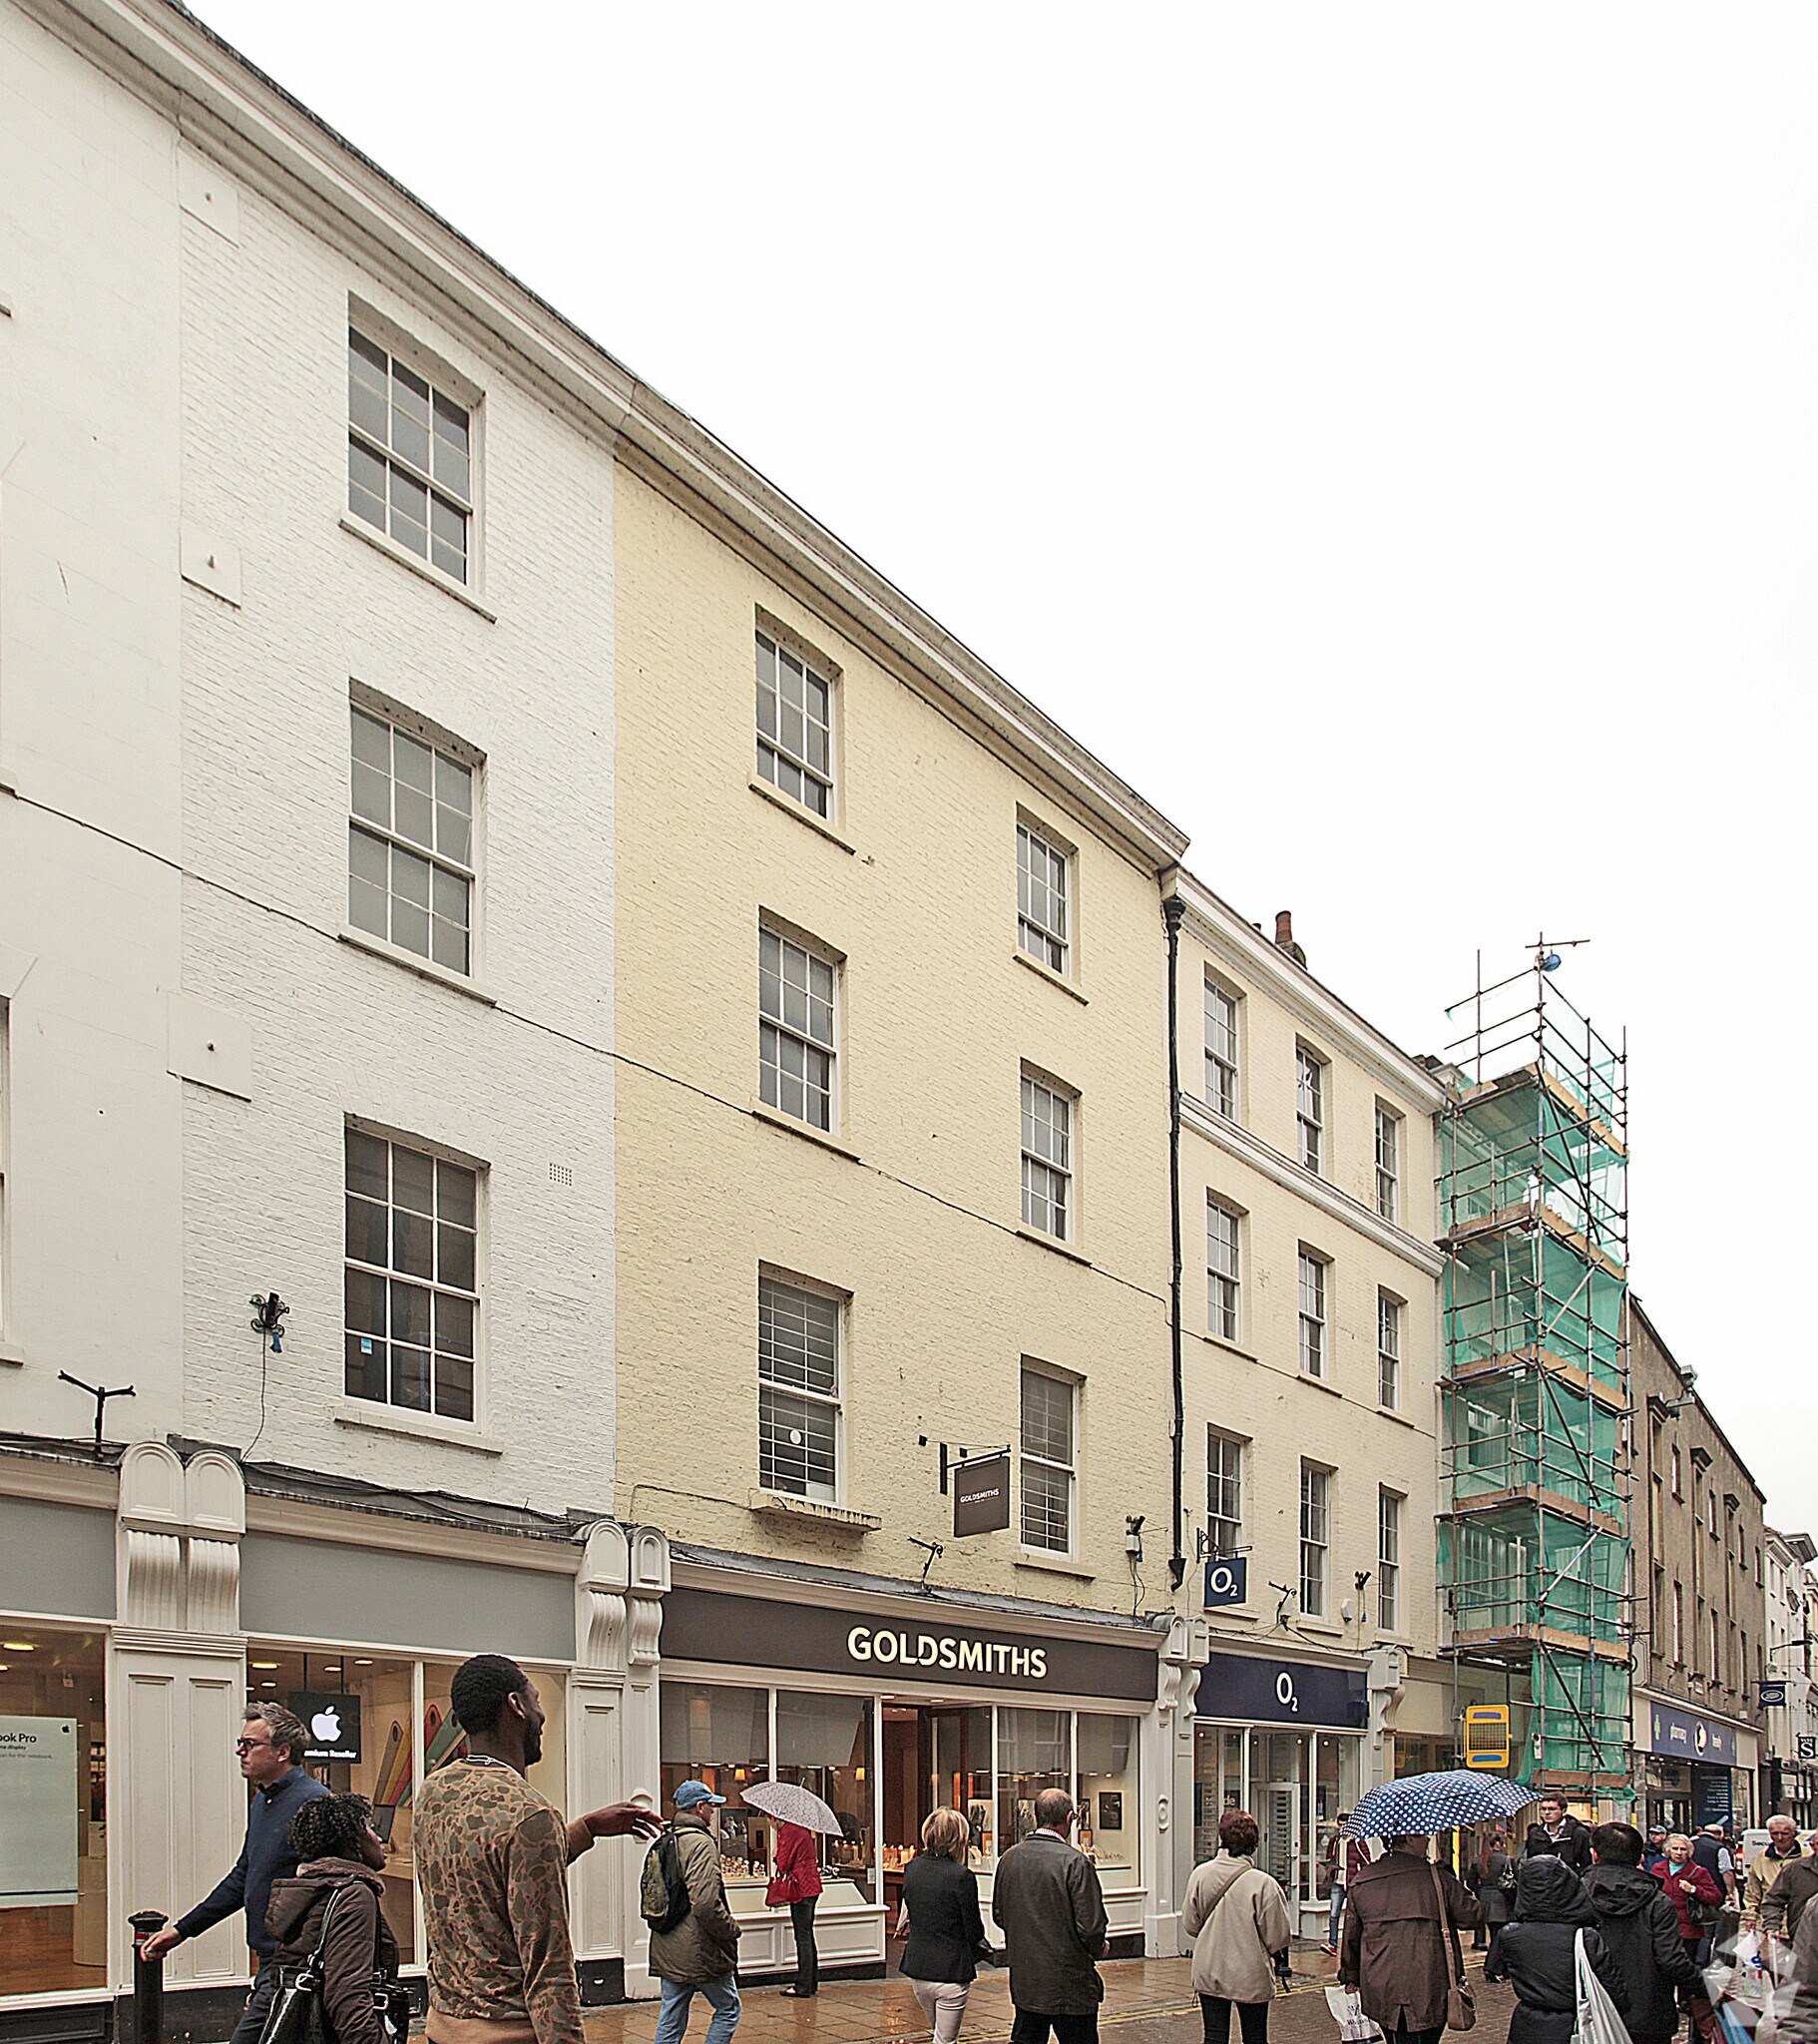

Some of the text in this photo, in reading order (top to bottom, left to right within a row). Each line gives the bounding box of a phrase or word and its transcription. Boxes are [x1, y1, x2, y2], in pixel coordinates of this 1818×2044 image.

[960, 1488, 1000, 1503] GOLDSMITHS
[1210, 1567, 1238, 1597] O2
[847, 1627, 1048, 1679] GOLDSMITHS
[1276, 1672, 1298, 1713] O2
[19, 1733, 37, 1743] Pro
